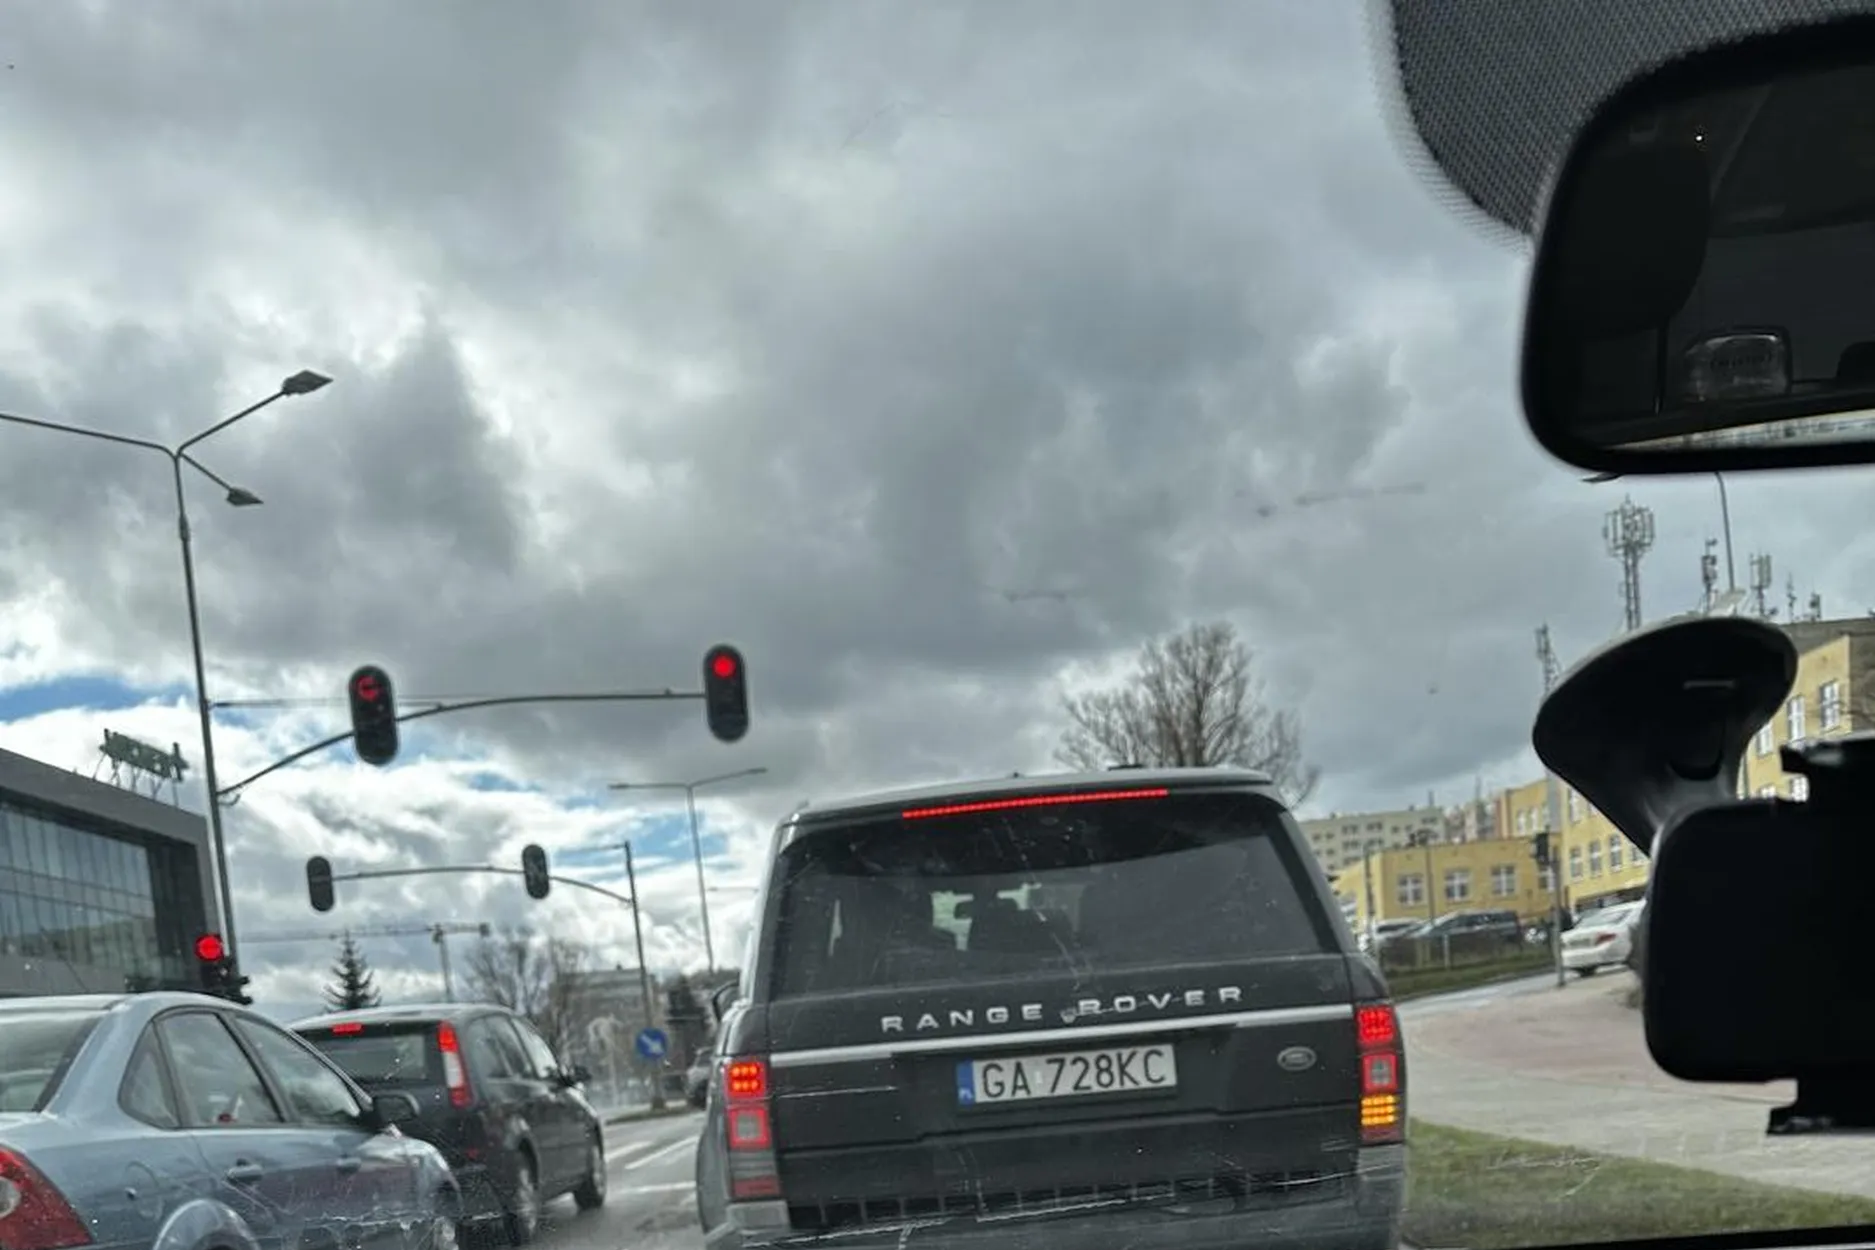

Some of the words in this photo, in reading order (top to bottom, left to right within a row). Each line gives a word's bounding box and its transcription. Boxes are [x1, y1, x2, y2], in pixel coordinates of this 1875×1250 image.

[881, 1003, 1043, 1032] RANGE
[1078, 986, 1243, 1015] ROVER
[982, 1061, 1031, 1099] GA
[1046, 1049, 1166, 1094] 728KC
